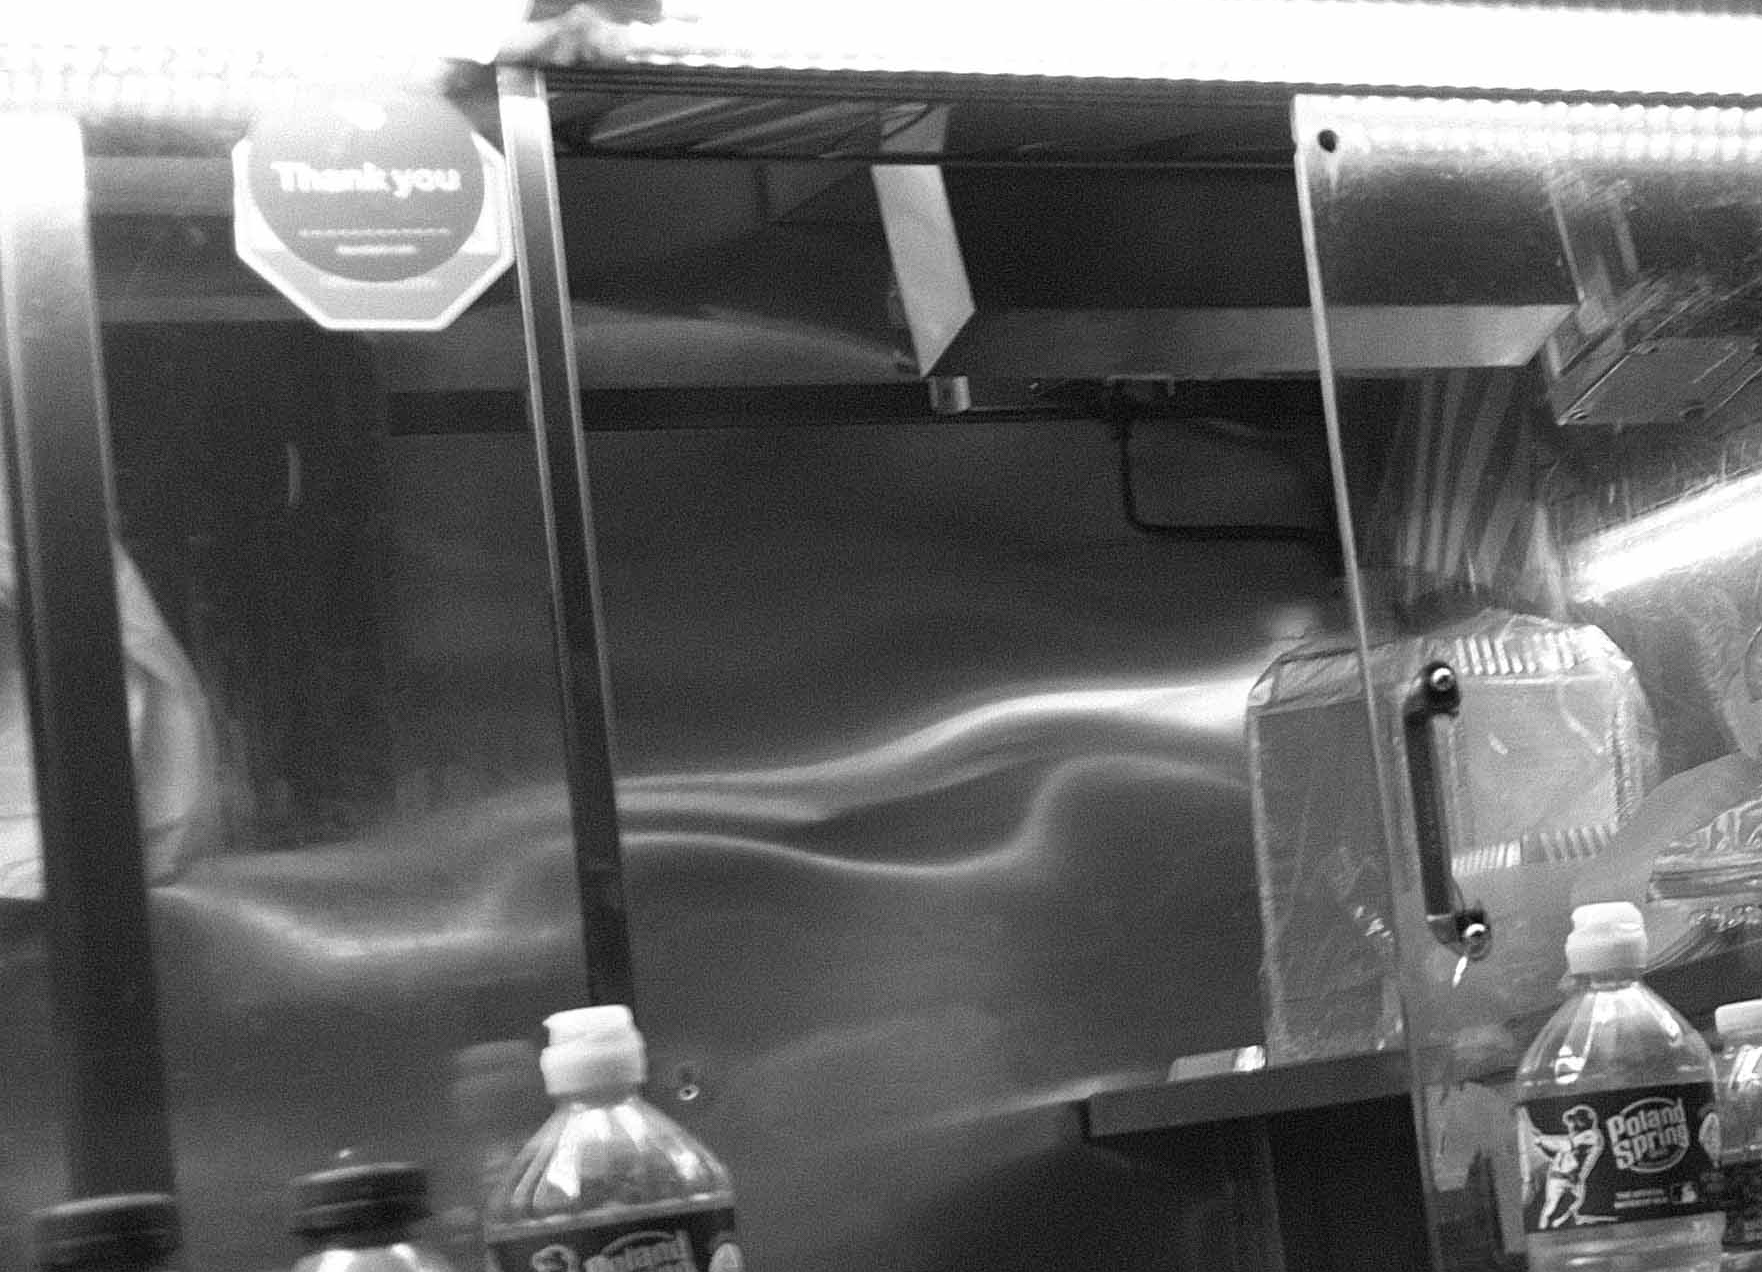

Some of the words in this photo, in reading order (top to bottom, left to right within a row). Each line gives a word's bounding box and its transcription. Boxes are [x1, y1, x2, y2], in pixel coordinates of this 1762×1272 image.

[269, 162, 390, 192] Thank
[391, 167, 462, 199] you
[1606, 1097, 1686, 1145] Poland
[1614, 1123, 1690, 1170] Spring
